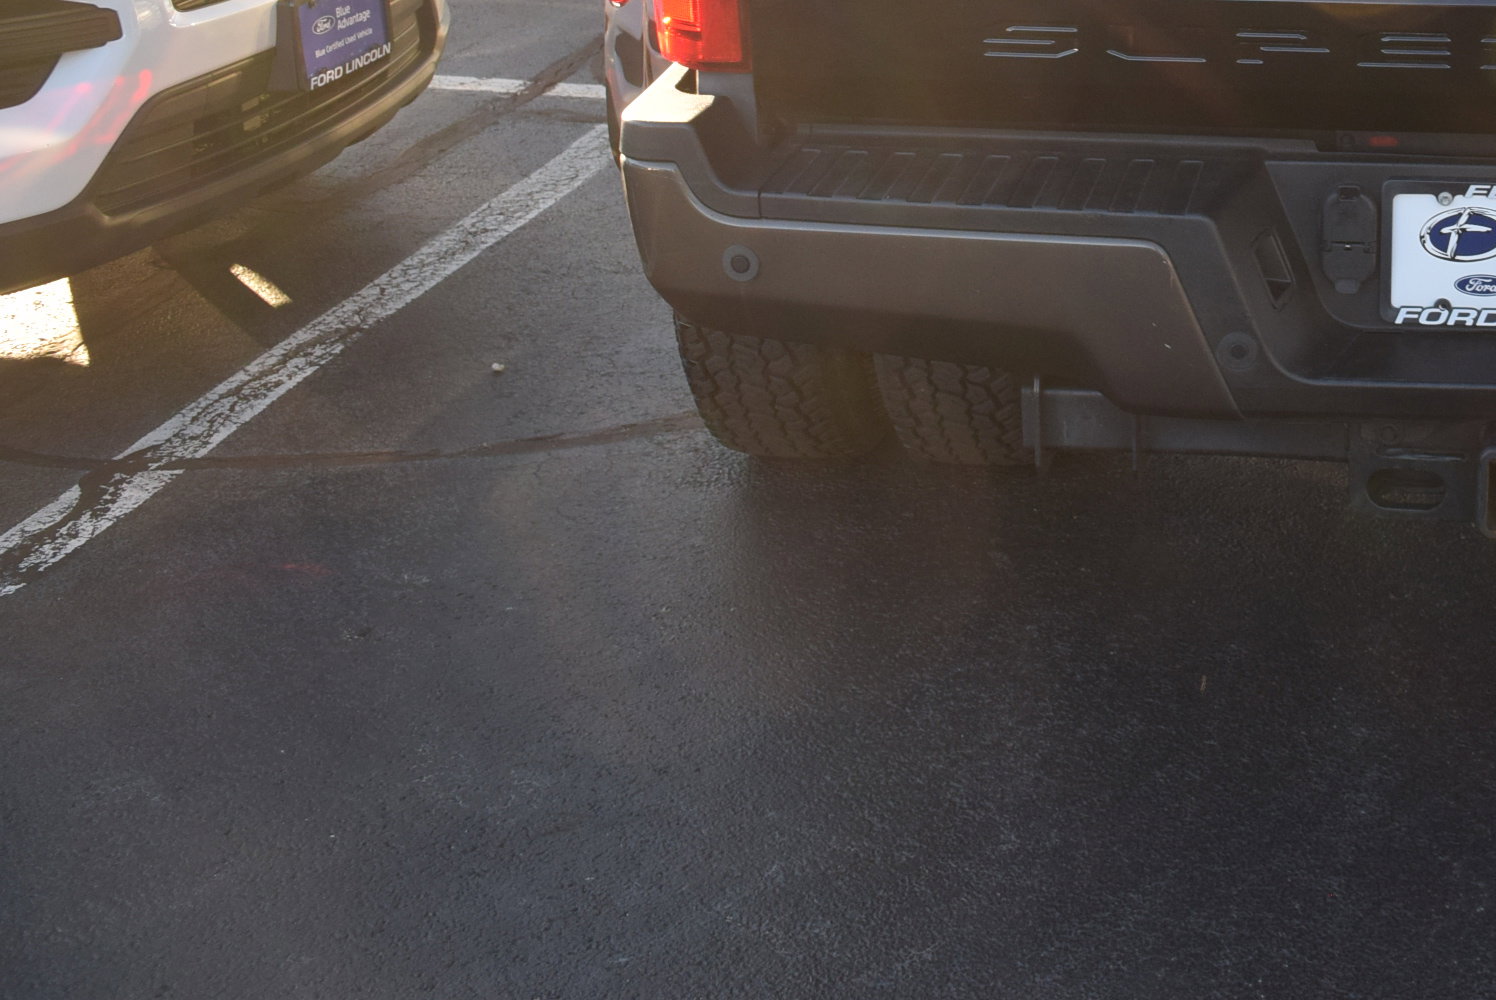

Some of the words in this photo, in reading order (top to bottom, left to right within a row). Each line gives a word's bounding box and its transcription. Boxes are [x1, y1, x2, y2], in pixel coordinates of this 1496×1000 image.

[335, 5, 350, 18] Blue
[338, 9, 370, 30] Advantage
[310, 66, 343, 91] FORD
[345, 42, 391, 74] LINCOLN
